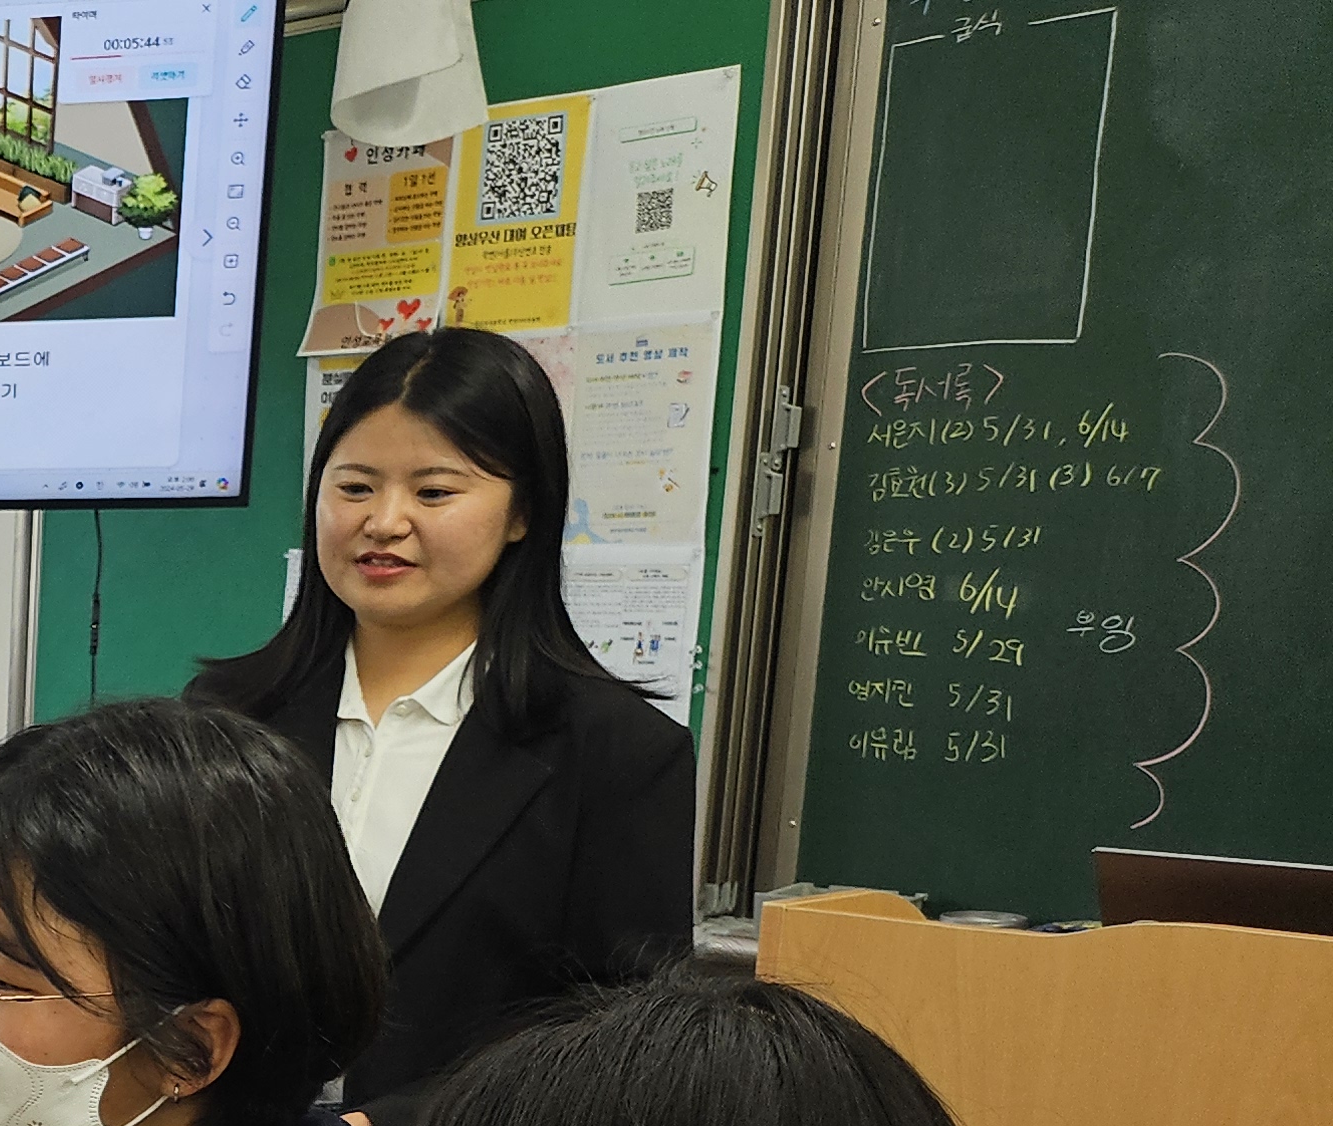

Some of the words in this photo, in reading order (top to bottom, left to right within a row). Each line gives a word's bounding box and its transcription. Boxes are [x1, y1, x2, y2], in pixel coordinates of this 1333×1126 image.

[951, 9, 1002, 43] 급식
[104, 36, 160, 51] 00:05:44
[504, 227, 527, 243] 대여
[531, 222, 577, 240] 오픈채팅
[1078, 402, 1129, 448] 6/14
[977, 462, 1036, 493] 5/31
[1050, 462, 1092, 491] (3)
[1106, 465, 1162, 492] 6/7
[981, 525, 1041, 552] 5/31
[959, 567, 1018, 620] 6/14
[855, 625, 927, 657] 이유빈
[952, 629, 1025, 666] 5/29
[948, 683, 1011, 722] 5/31
[944, 730, 1005, 762] 5/31
